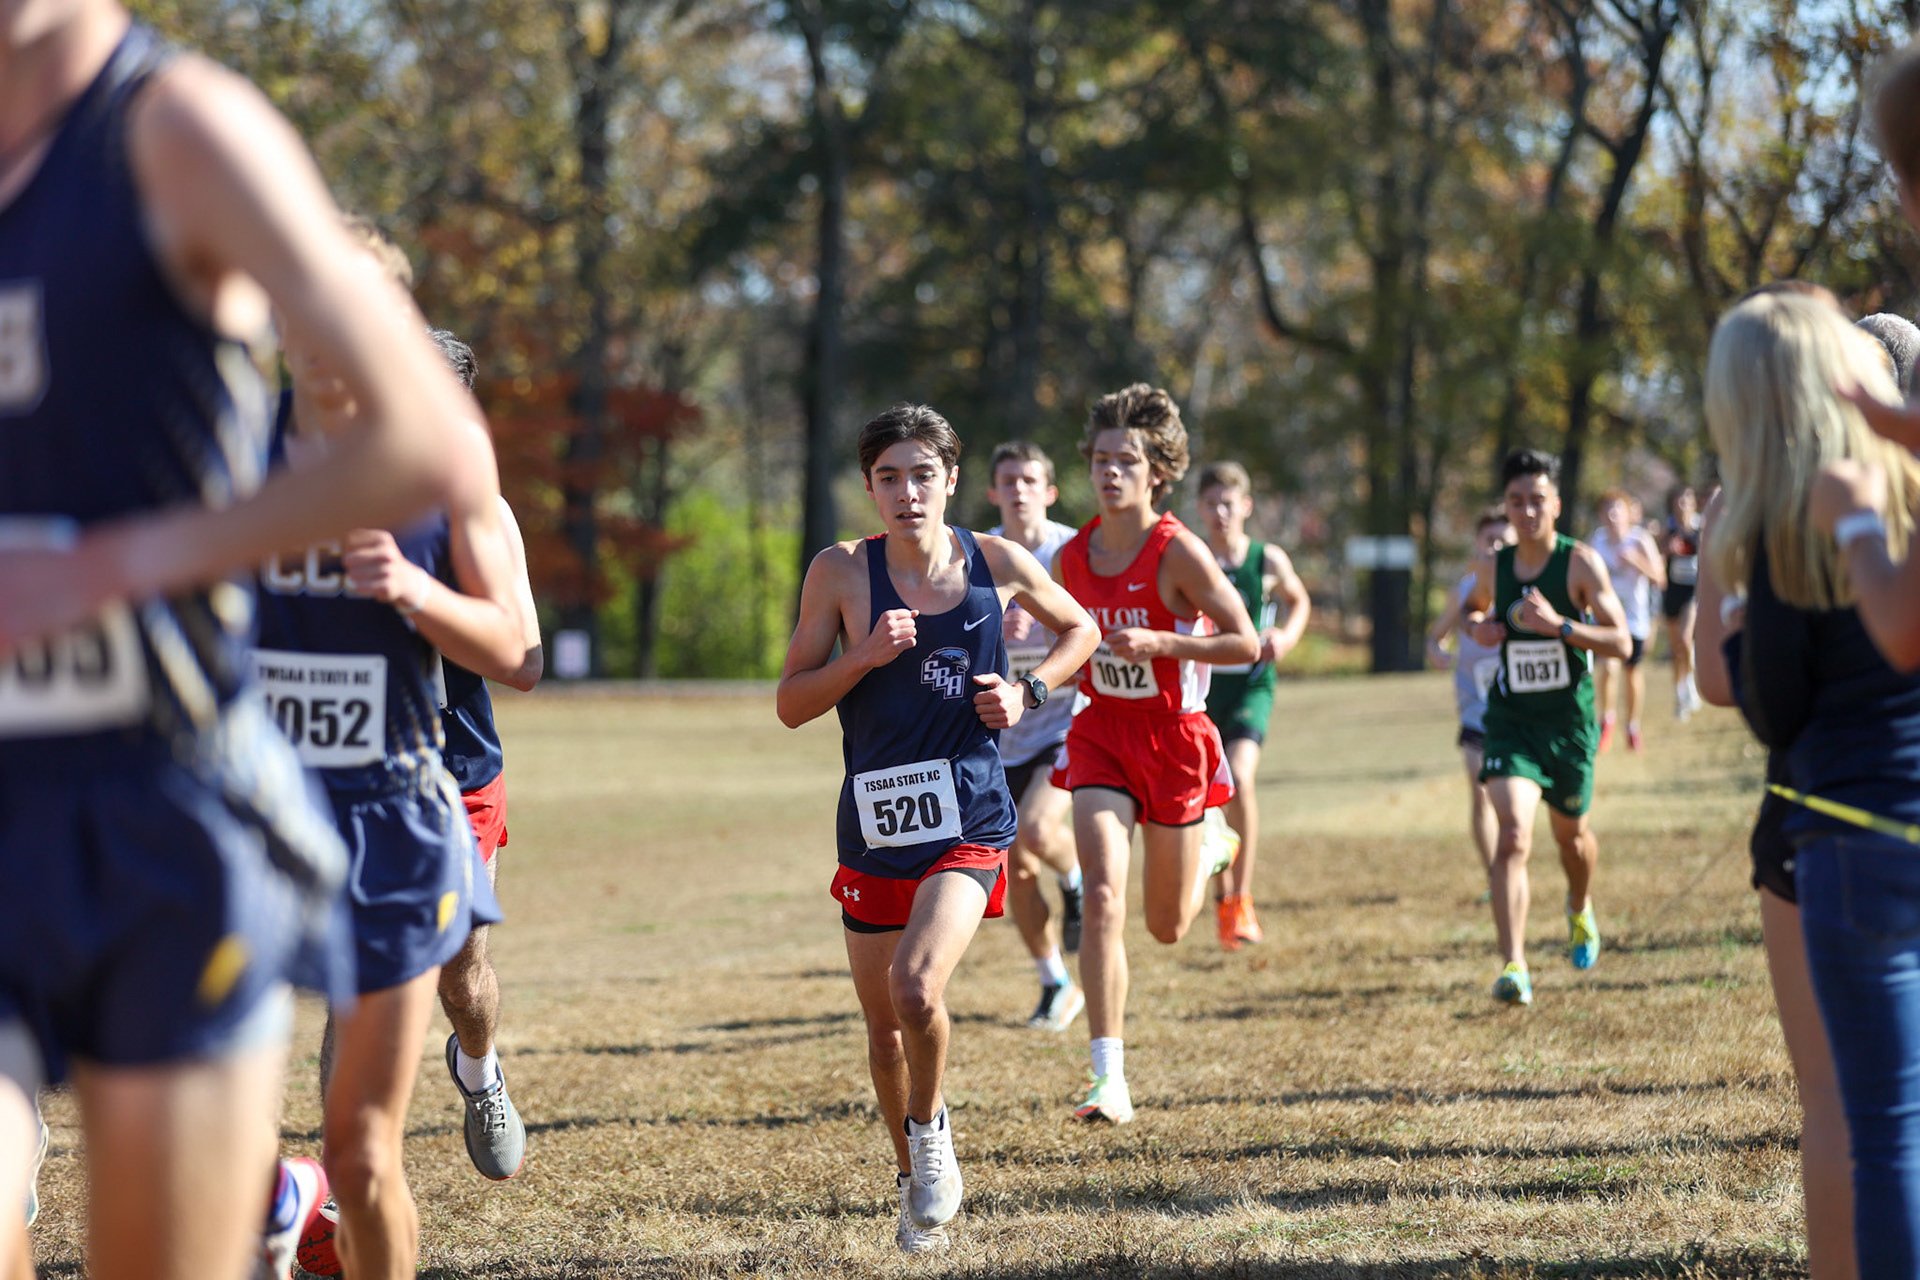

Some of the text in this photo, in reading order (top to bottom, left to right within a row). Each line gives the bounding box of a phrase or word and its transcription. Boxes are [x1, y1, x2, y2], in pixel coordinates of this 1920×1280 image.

[262, 540, 358, 597] CC
[922, 659, 964, 697] SBA
[1096, 661, 1148, 689] 1012
[1516, 660, 1560, 682] 1037
[864, 769, 941, 793] TSSAA STATE XC
[873, 791, 942, 837] 520
